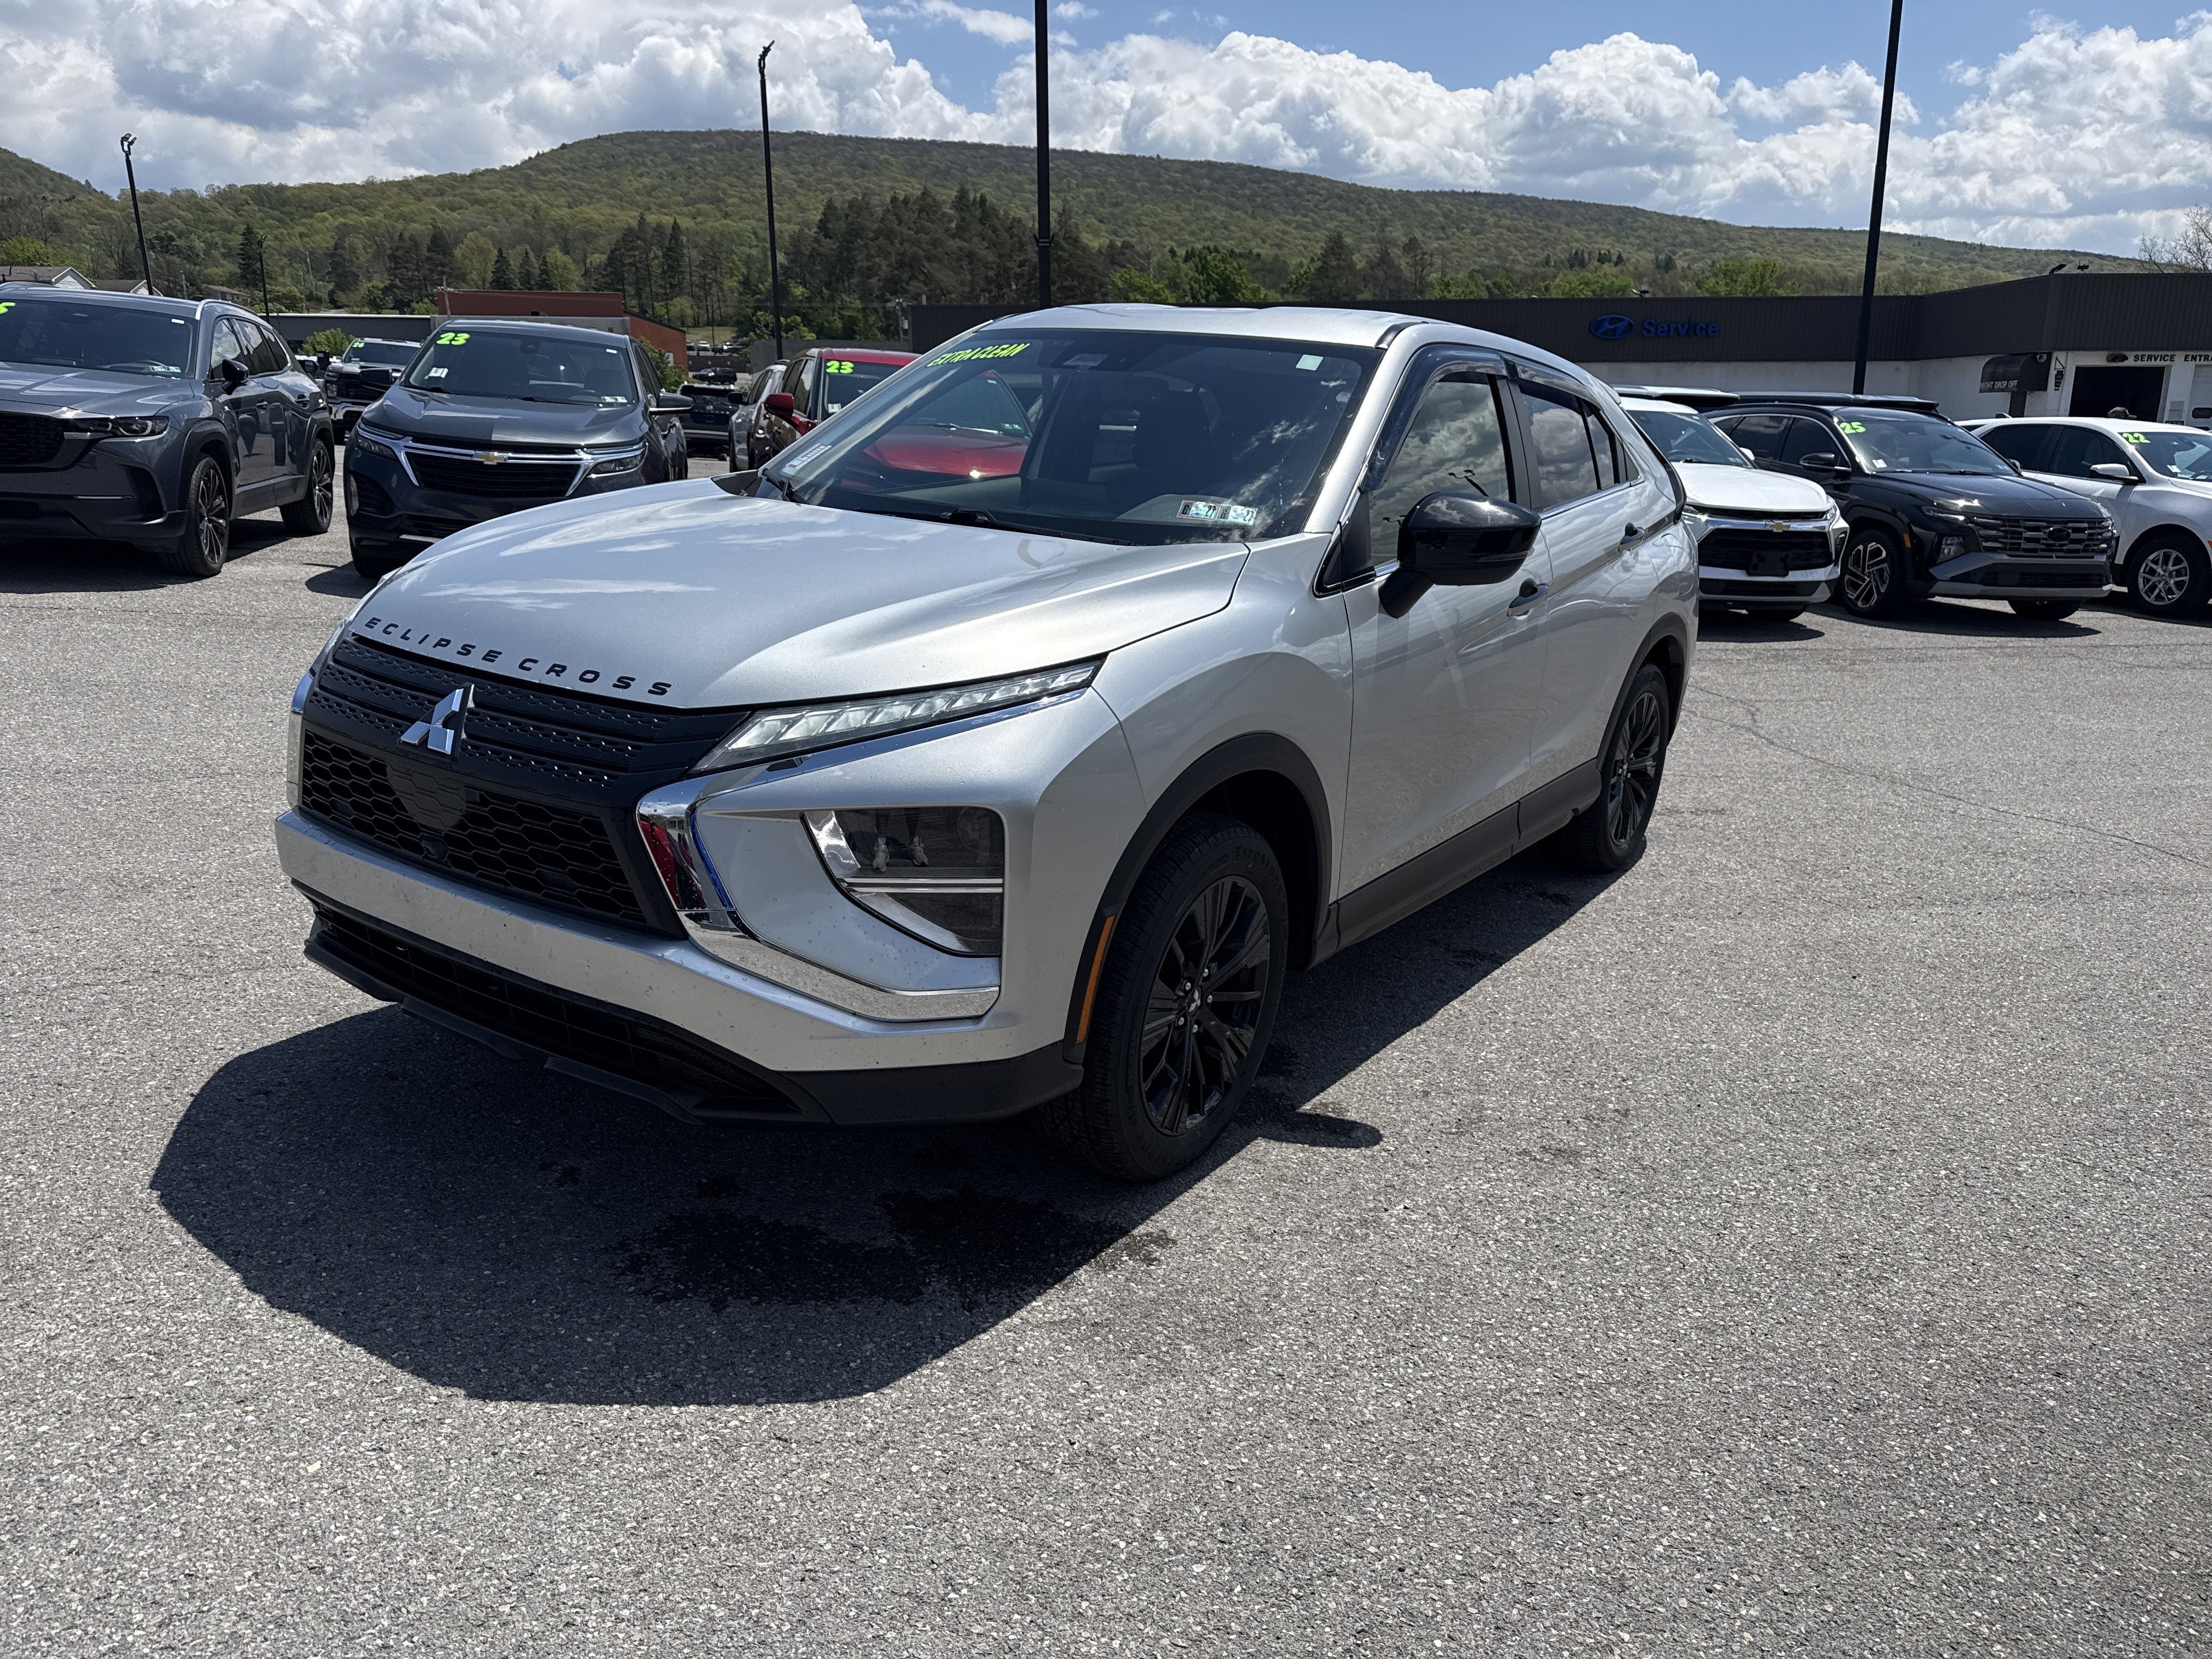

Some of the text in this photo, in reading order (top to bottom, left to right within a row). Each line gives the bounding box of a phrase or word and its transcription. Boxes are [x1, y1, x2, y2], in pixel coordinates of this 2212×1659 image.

[1642, 318, 1719, 337] Service
[436, 332, 470, 346] 23
[927, 343, 1030, 367] EXTRA CLEAN
[2134, 354, 2176, 362] SERVICE
[826, 360, 854, 374] 23
[1994, 380, 2008, 389] DROP
[2008, 380, 2018, 388] OFF
[1840, 421, 1866, 435] 25
[2122, 432, 2152, 444] 22
[364, 617, 673, 697] ECLIPSE CROSS
[1234, 845, 1284, 896] Firestone
